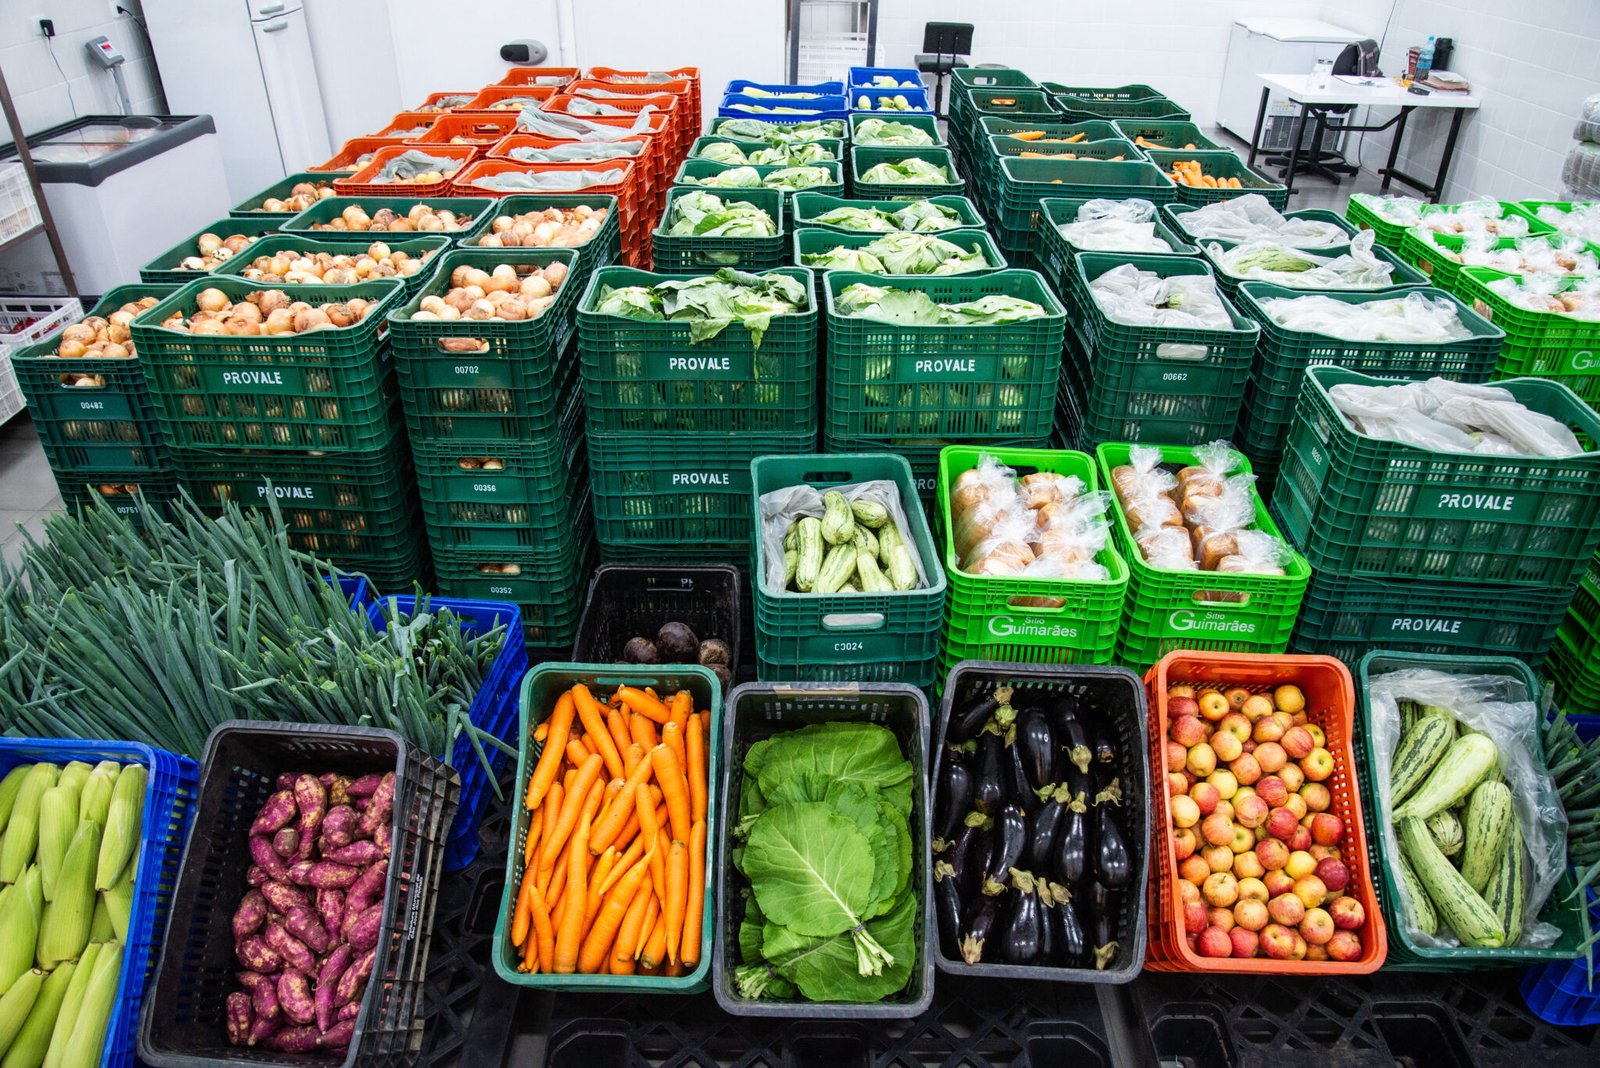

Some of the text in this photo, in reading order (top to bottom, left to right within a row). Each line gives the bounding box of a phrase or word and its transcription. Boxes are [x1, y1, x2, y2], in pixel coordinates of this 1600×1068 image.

[454, 366, 479, 374] 00702
[669, 357, 730, 370] PROVALE
[915, 359, 976, 373] PROVALE
[223, 371, 283, 384] PROVALE
[1163, 372, 1188, 381] 00662
[80, 401, 104, 409] 00482
[672, 473, 730, 485] PROVALE
[473, 484, 497, 492] 00356
[1438, 494, 1515, 511] PROVALE
[988, 615, 1078, 637] Guimarães
[1169, 609, 1256, 633] Guimarães
[1391, 618, 1462, 634] PROVALE
